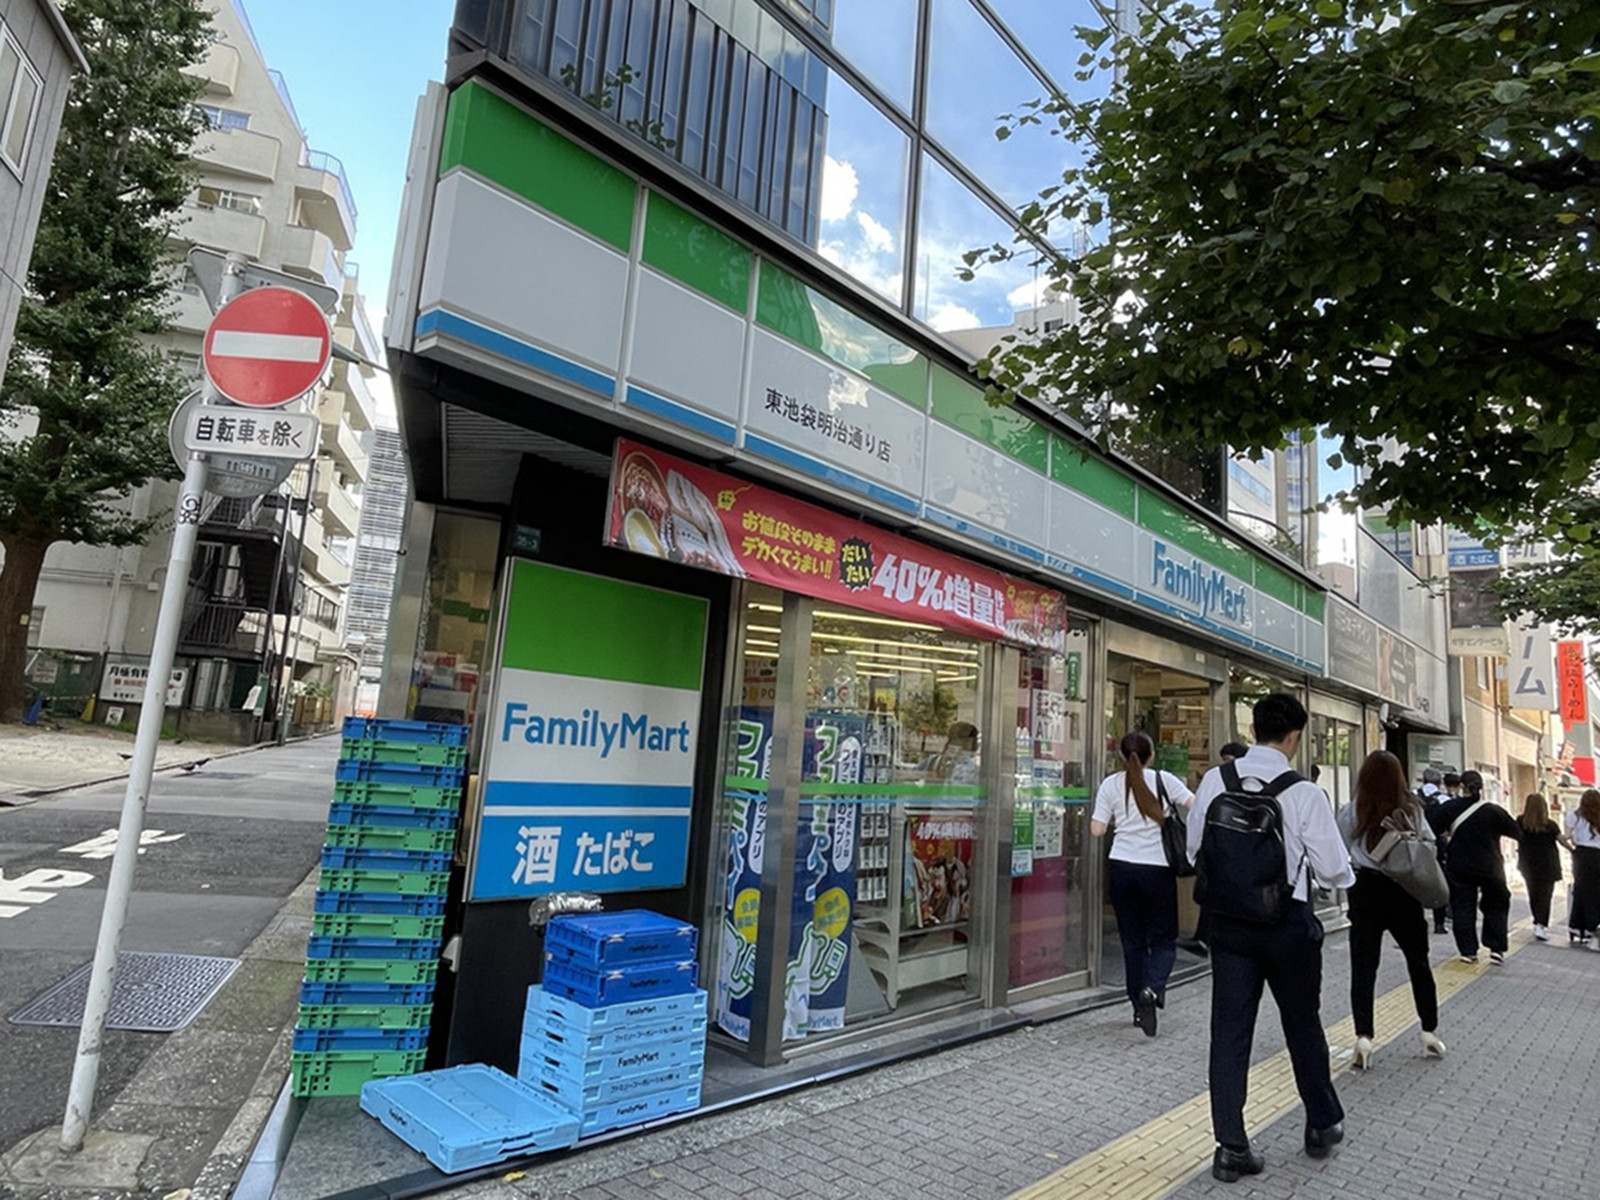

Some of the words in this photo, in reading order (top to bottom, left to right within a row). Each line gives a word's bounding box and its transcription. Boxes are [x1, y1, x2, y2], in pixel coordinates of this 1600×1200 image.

[196, 416, 303, 448] 自転車を除く
[765, 387, 892, 463] 東池袋明治通り店
[742, 510, 836, 555] お値段そのまま
[842, 544, 867, 563] だい
[846, 565, 871, 583] たい
[1152, 540, 1248, 625] FamilyMart
[502, 702, 690, 759] FamilyMart
[511, 825, 562, 885] 酒
[573, 829, 655, 876] たばこ
[617, 1051, 660, 1068] FamilyMart
[616, 1102, 648, 1116] FamilyMart
